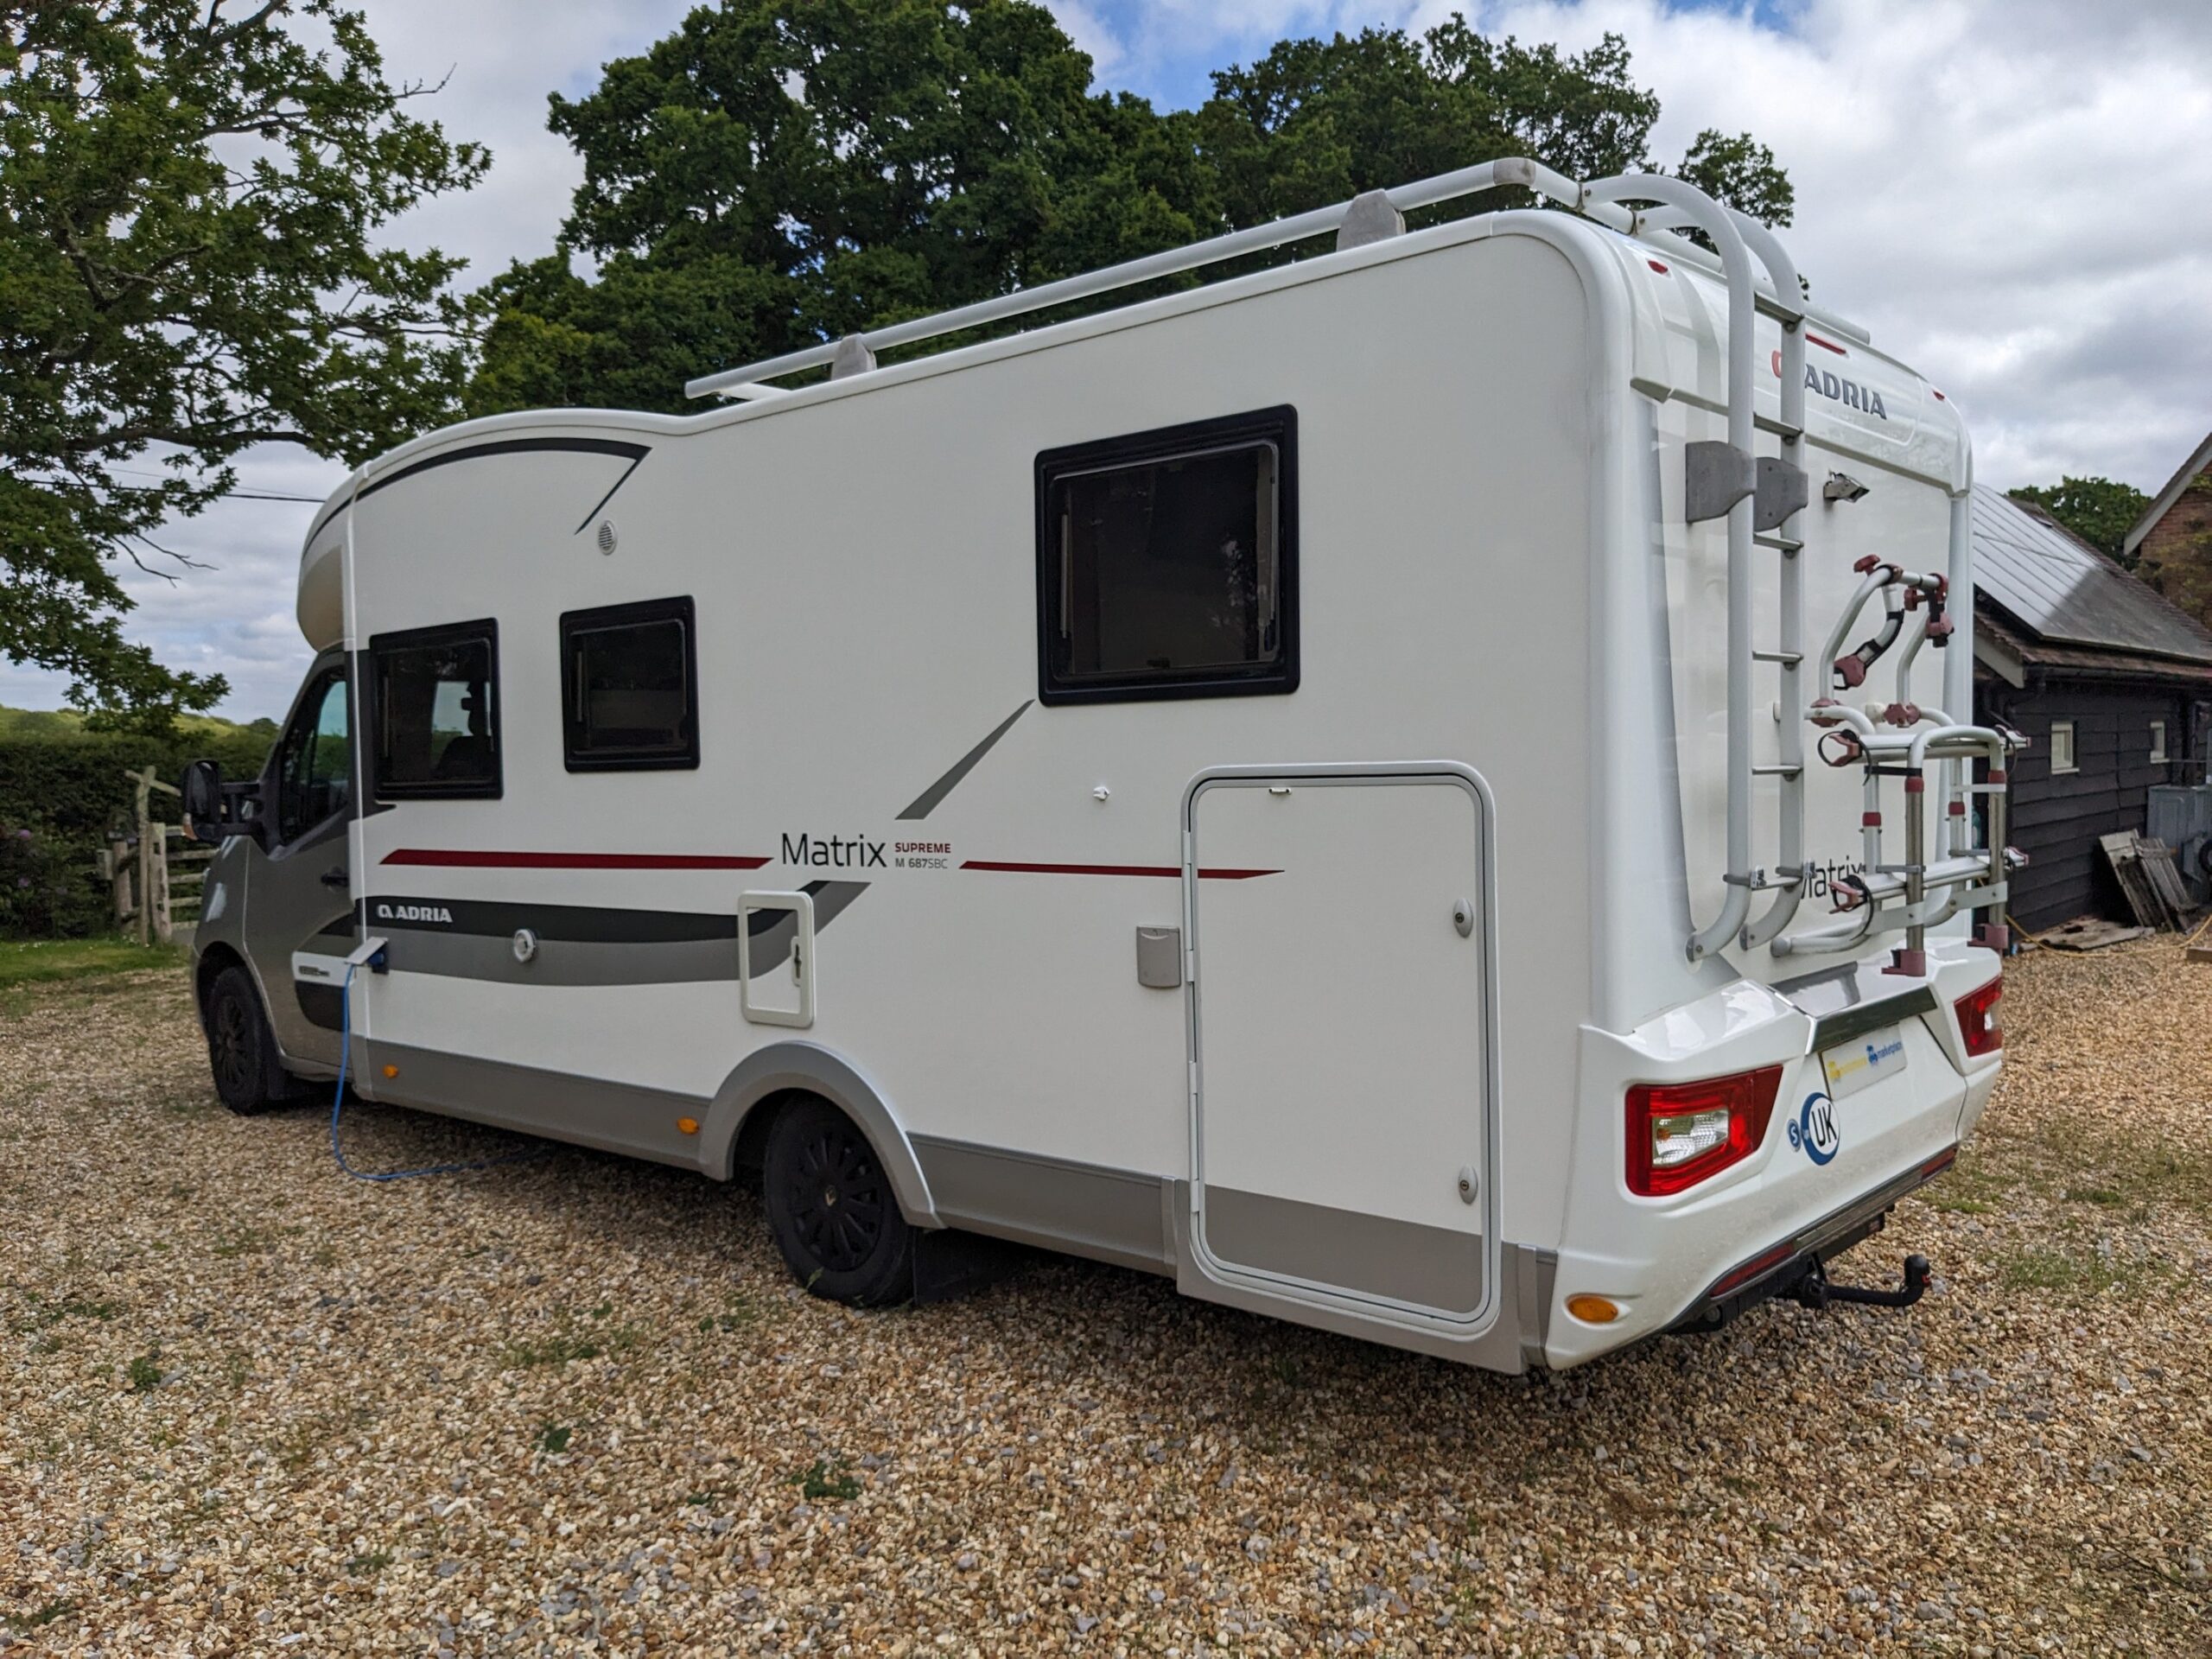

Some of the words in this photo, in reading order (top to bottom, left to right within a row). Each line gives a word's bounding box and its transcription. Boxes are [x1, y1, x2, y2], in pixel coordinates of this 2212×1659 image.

[1805, 363, 1887, 421] ADRIA
[782, 832, 887, 868] Matrix
[894, 842, 951, 854] SUPREME
[894, 858, 906, 868] M
[908, 858, 949, 869] 687SBC
[396, 904, 454, 923] ADRIA
[1811, 1103, 1838, 1147] UK
